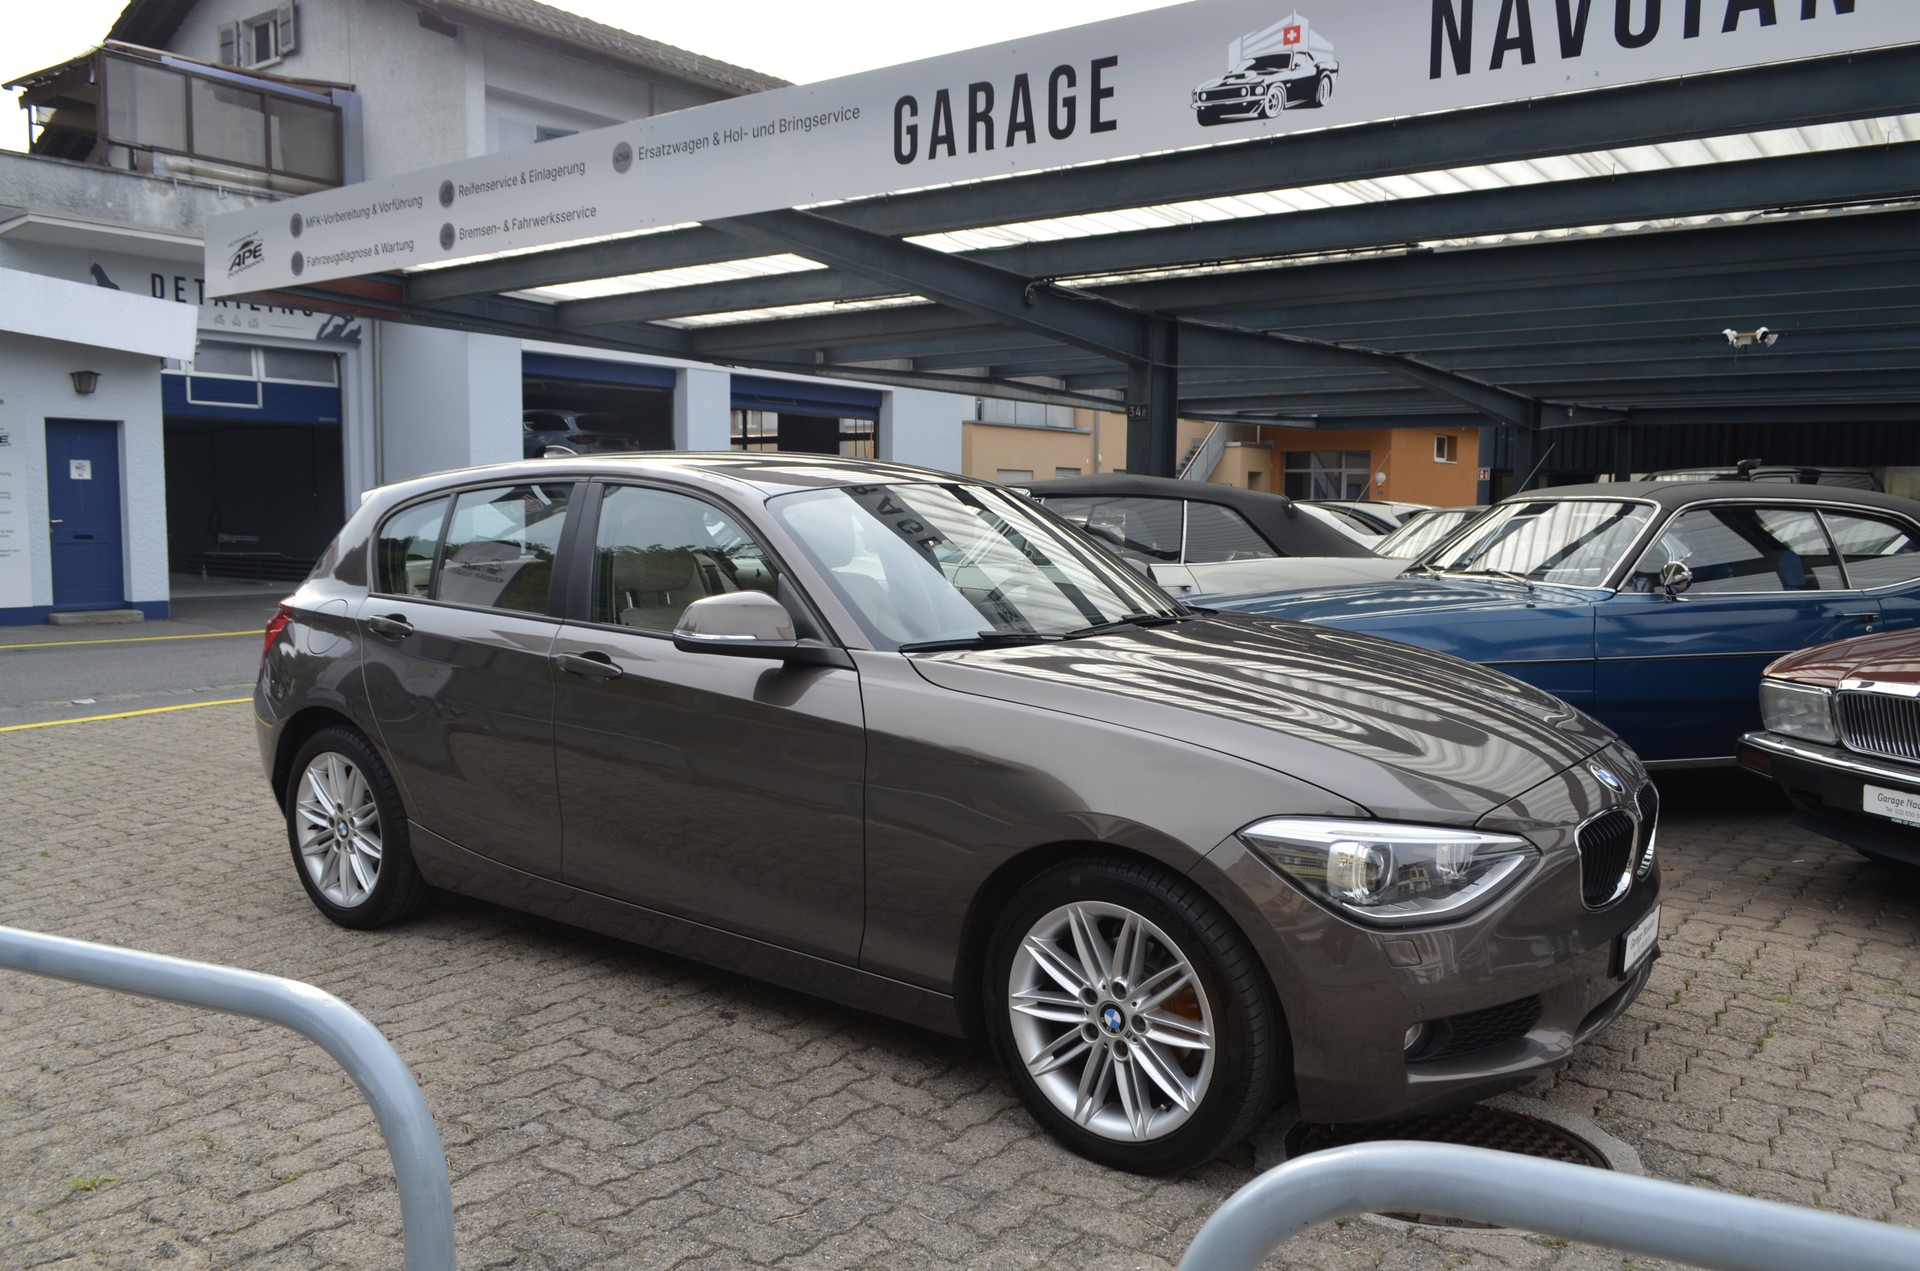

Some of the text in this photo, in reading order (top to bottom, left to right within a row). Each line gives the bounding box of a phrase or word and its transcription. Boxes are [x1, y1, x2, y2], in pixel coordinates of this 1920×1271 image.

[893, 55, 1118, 165] GARAGE
[638, 106, 860, 161] Ersatzwagen & Hol- und Bringservice
[458, 162, 586, 197] Reifenservice & Einlagerung
[305, 196, 423, 228] MFK-Vorbereitung & Vorführung
[459, 205, 597, 240] Bremsen- & Fahrwerksservice
[229, 243, 262, 271] APE
[306, 240, 414, 267] Fahrzeugdiagnose & Wartung
[1877, 792, 1905, 808] Garage
